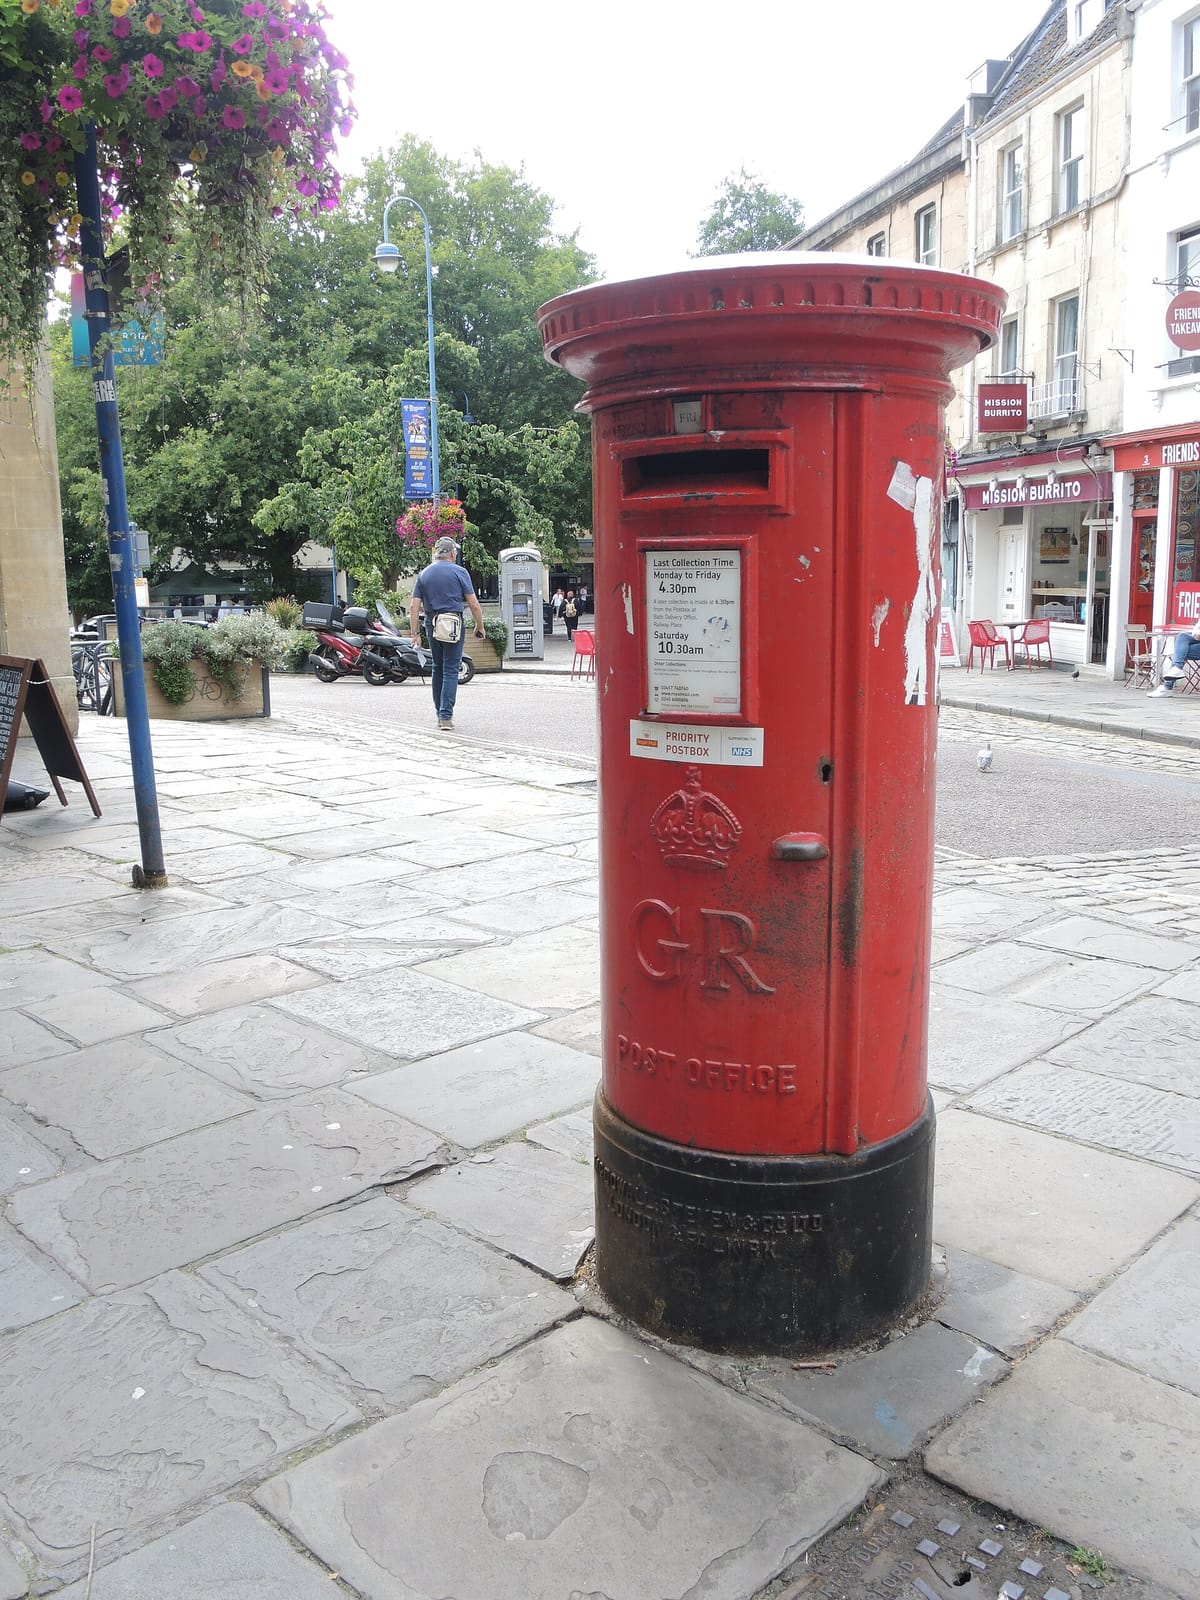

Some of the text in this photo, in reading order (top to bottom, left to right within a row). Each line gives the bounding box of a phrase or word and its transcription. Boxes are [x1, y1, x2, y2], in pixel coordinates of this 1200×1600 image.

[984, 398, 1022, 407] MISSION
[679, 412, 697, 424] FRI
[984, 409, 1022, 417] BURRITO
[1143, 441, 1200, 464] 3 FRIENDS
[982, 480, 1081, 505] MISSION BURRITO
[653, 558, 734, 567] Last Collection Time
[653, 571, 721, 580] Monday to Friday
[658, 580, 697, 595] 4.30pm
[515, 632, 532, 640] cash
[654, 631, 689, 641] Saturday
[658, 641, 704, 655] 10.30am
[666, 731, 710, 744] PRIORITY
[666, 744, 709, 757] POSTBOX
[732, 748, 752, 757] NHS
[618, 1033, 797, 1095] POST OFFICE
